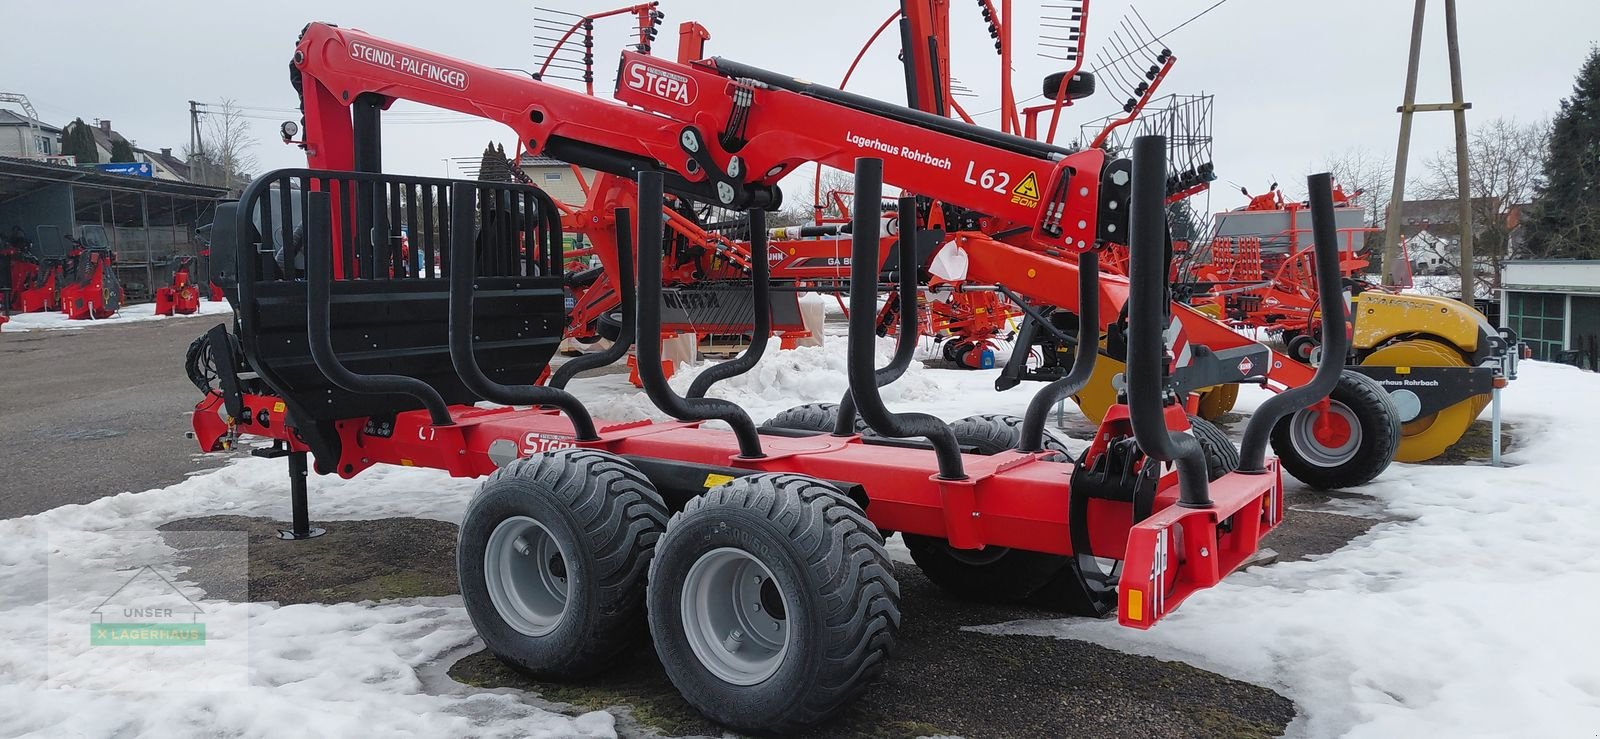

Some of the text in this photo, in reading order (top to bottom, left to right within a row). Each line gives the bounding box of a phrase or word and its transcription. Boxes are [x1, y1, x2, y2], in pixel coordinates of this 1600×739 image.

[352, 43, 465, 88] STEINDL-PALFINGER
[629, 63, 689, 104] STEPA
[846, 131, 952, 170] Lagerhaus Rohrbach
[964, 161, 1010, 195] L62
[1011, 195, 1038, 208] 20M
[769, 253, 784, 261] UHN
[827, 257, 841, 265] GA
[1404, 379, 1439, 387] Rohrbach
